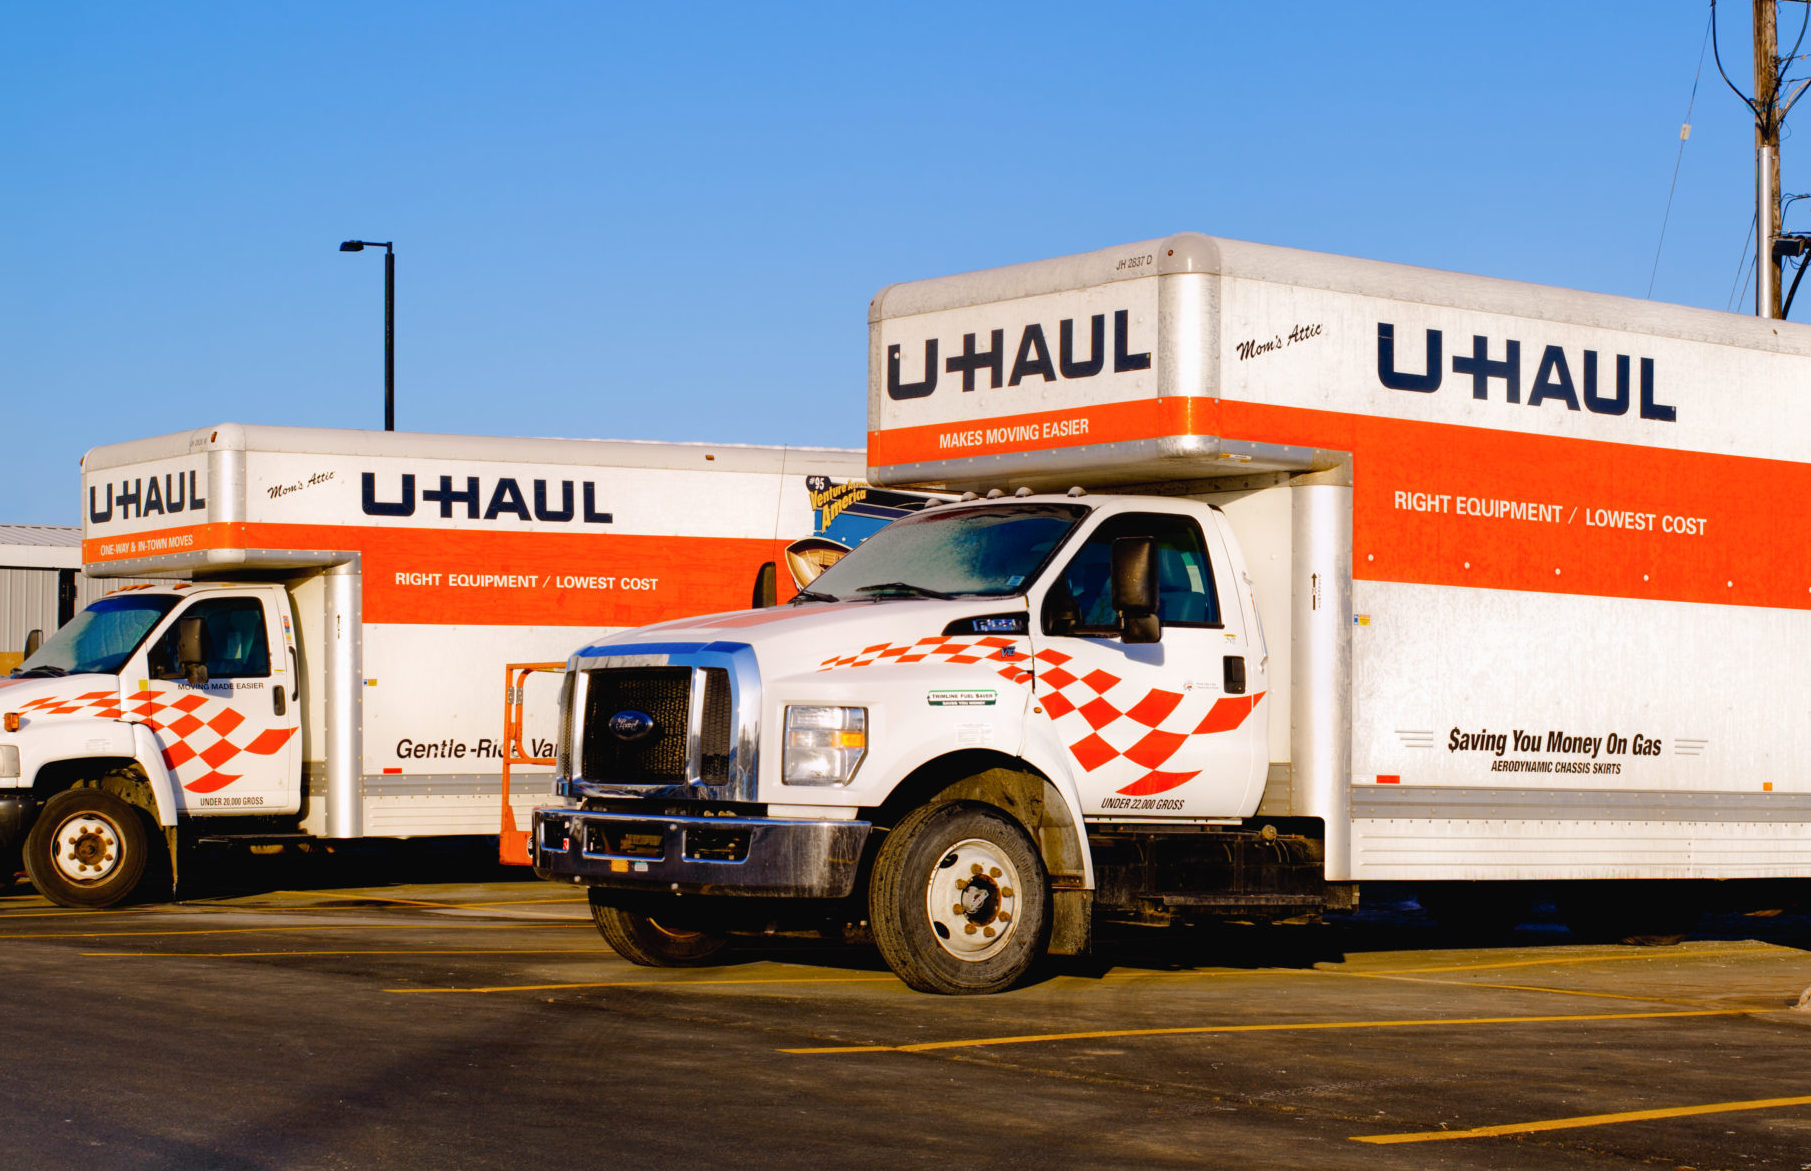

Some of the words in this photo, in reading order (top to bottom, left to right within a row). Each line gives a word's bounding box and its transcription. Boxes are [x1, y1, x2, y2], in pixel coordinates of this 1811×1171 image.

[887, 309, 1151, 401] U-HAUL
[1236, 334, 1282, 361] Mom's
[1288, 323, 1324, 345] Attic
[1377, 322, 1677, 422] U-HAUL
[939, 428, 983, 449] MAKES
[985, 423, 1040, 446] MOVING
[1042, 418, 1089, 439] EASIER
[89, 470, 206, 524] U-HAUL
[267, 480, 303, 500] Mom's
[307, 471, 336, 489] Attic
[361, 472, 613, 524] U-HAUL
[808, 477, 825, 490] #95
[809, 484, 847, 512] Venture
[821, 487, 867, 535] America
[1394, 490, 1451, 514] RIGHT
[1455, 496, 1563, 524] EQUIPMENT
[1585, 507, 1656, 532] LOWEST
[1662, 513, 1707, 536] COST
[100, 540, 130, 557] ONE-WAY
[130, 541, 137, 553] &
[138, 537, 167, 552] IN-TOWN
[168, 534, 194, 549] MOVES
[395, 572, 442, 586] RIGHT
[448, 573, 538, 588] EQUIPMENT
[556, 575, 616, 590] LOWEST
[620, 577, 659, 591] COST
[212, 682, 234, 690] MADE
[236, 682, 264, 690] EASIER
[1448, 726, 1507, 756] $aving
[1512, 730, 1542, 752] You
[1546, 730, 1602, 759] Money
[1606, 732, 1628, 755] On
[1632, 734, 1662, 757] Gas
[1491, 759, 1553, 774] AERODYNAMIC
[1554, 761, 1590, 774] CHASSIS
[1592, 762, 1621, 775] SKIRTS
[200, 797, 222, 806] UNDER
[243, 796, 264, 806] GROSS
[1100, 798, 1129, 810] UNDER
[1129, 798, 1156, 811] 22,000
[1156, 799, 1185, 811] GROSS
